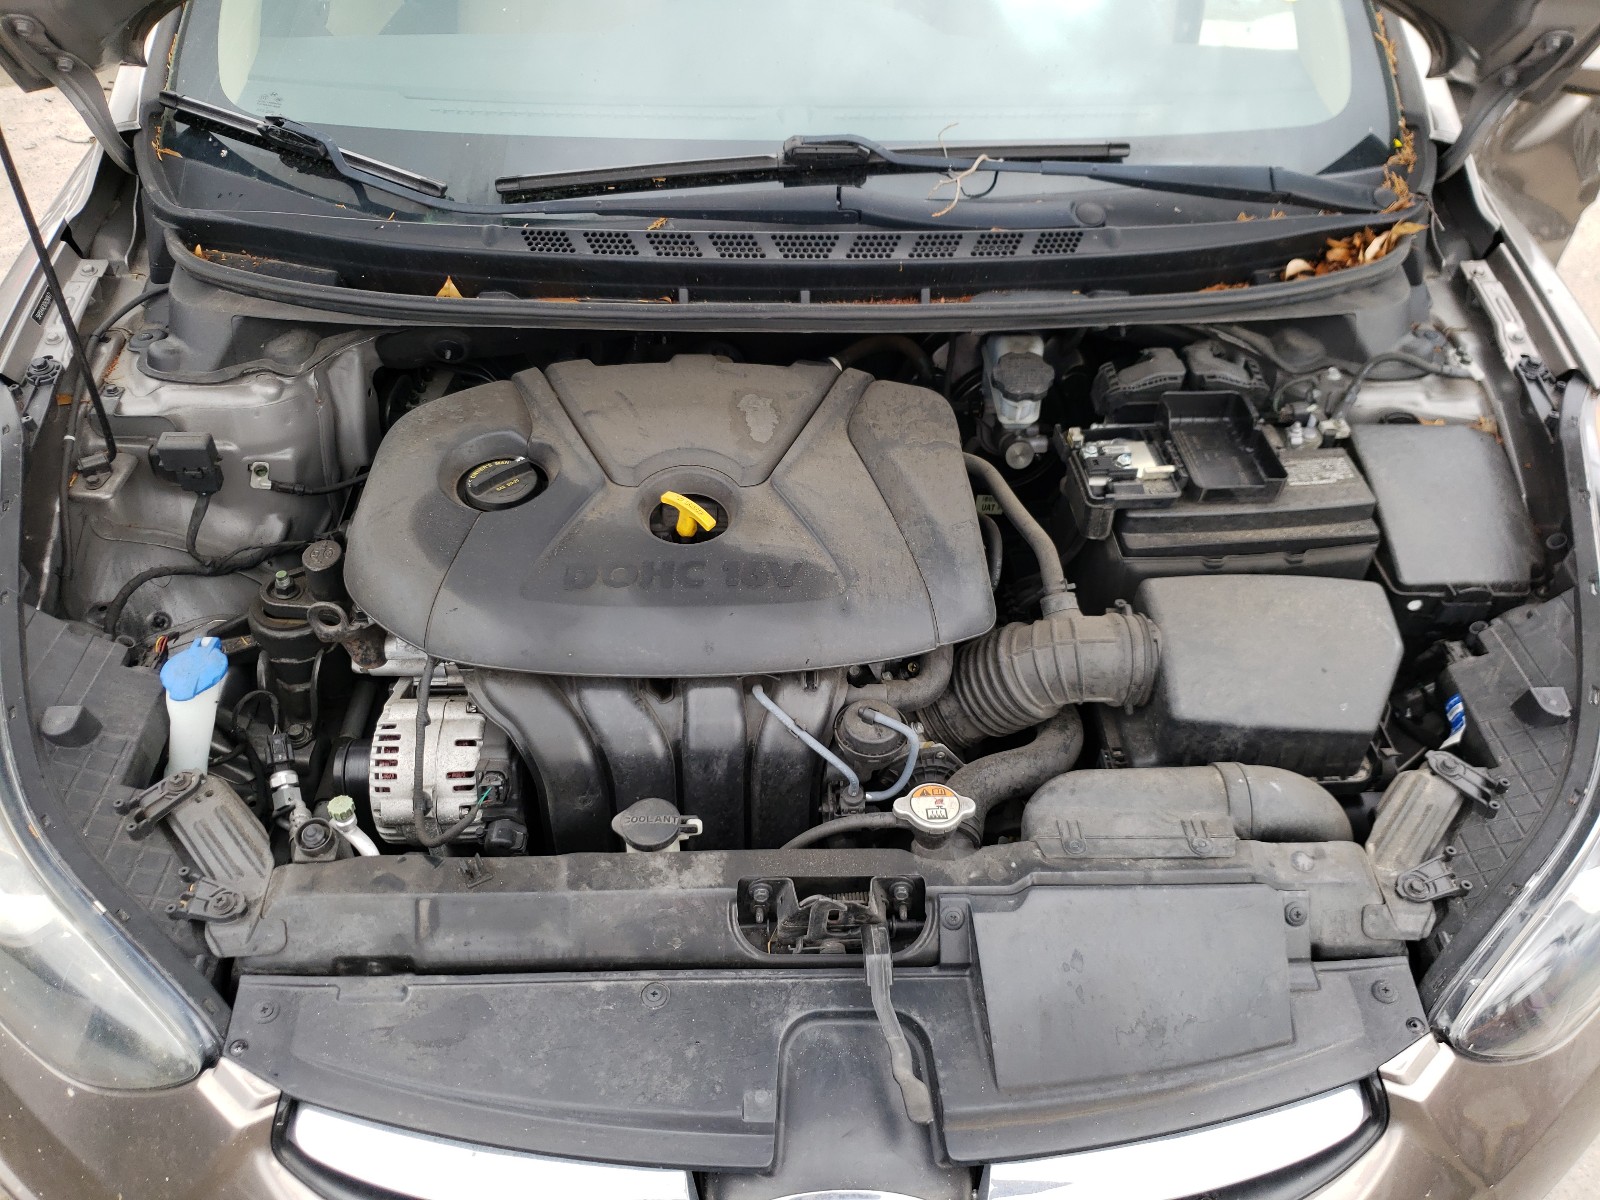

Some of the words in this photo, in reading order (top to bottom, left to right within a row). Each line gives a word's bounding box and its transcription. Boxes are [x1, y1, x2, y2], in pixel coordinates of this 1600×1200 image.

[563, 560, 707, 590] DOHC
[722, 560, 803, 588] 16V
[624, 815, 679, 824] COOLANT
